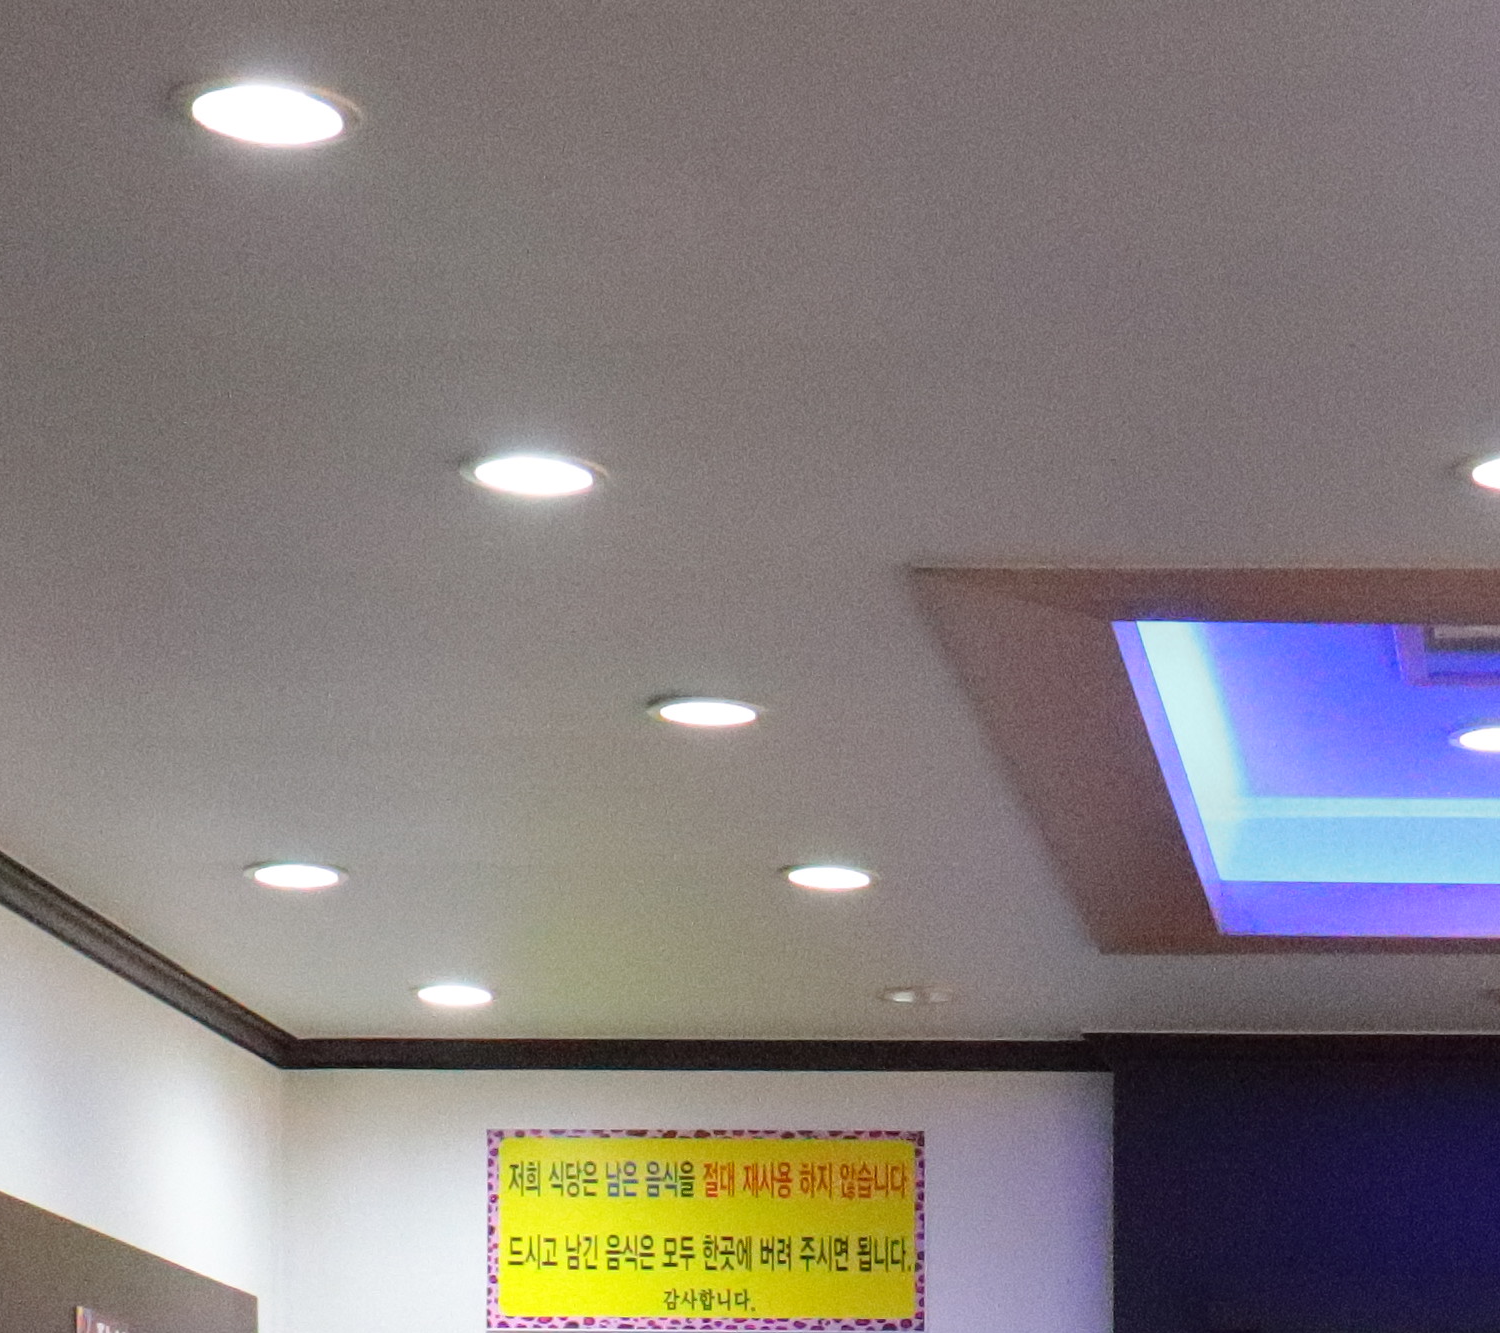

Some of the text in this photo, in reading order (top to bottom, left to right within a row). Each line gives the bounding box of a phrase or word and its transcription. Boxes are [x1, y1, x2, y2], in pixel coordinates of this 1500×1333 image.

[509, 1161, 908, 1199] 저희 식당은 남은 음식을 절대 재사용 하지 않습니다
[508, 1235, 913, 1272] 드시고 남긴 음식은 모두 한곳에 버려 주시면 됩니다.
[663, 1289, 756, 1312] 감사합니다.
